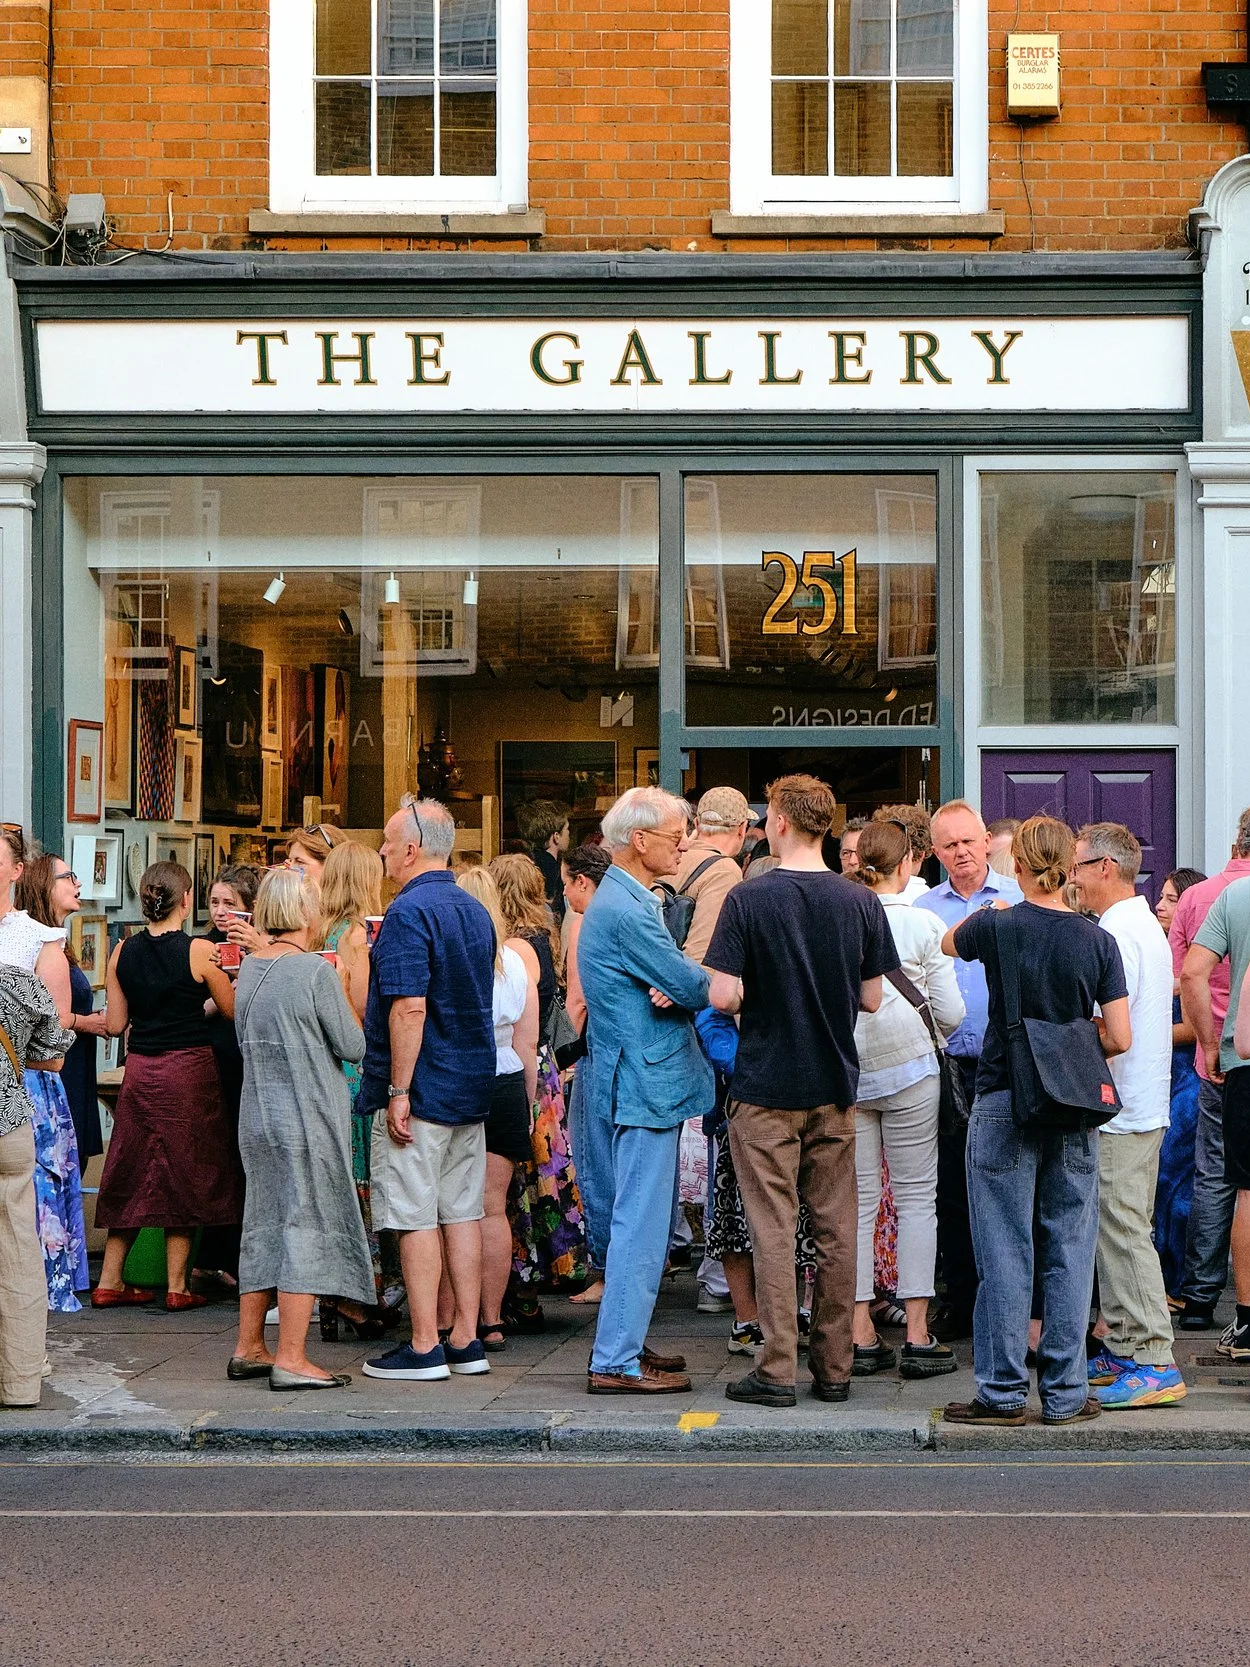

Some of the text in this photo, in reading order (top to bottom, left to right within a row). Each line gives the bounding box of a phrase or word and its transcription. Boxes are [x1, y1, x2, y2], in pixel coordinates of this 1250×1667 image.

[1012, 47, 1055, 59] CERTES
[236, 328, 1024, 387] THE GALLERY
[761, 547, 858, 636] 251
